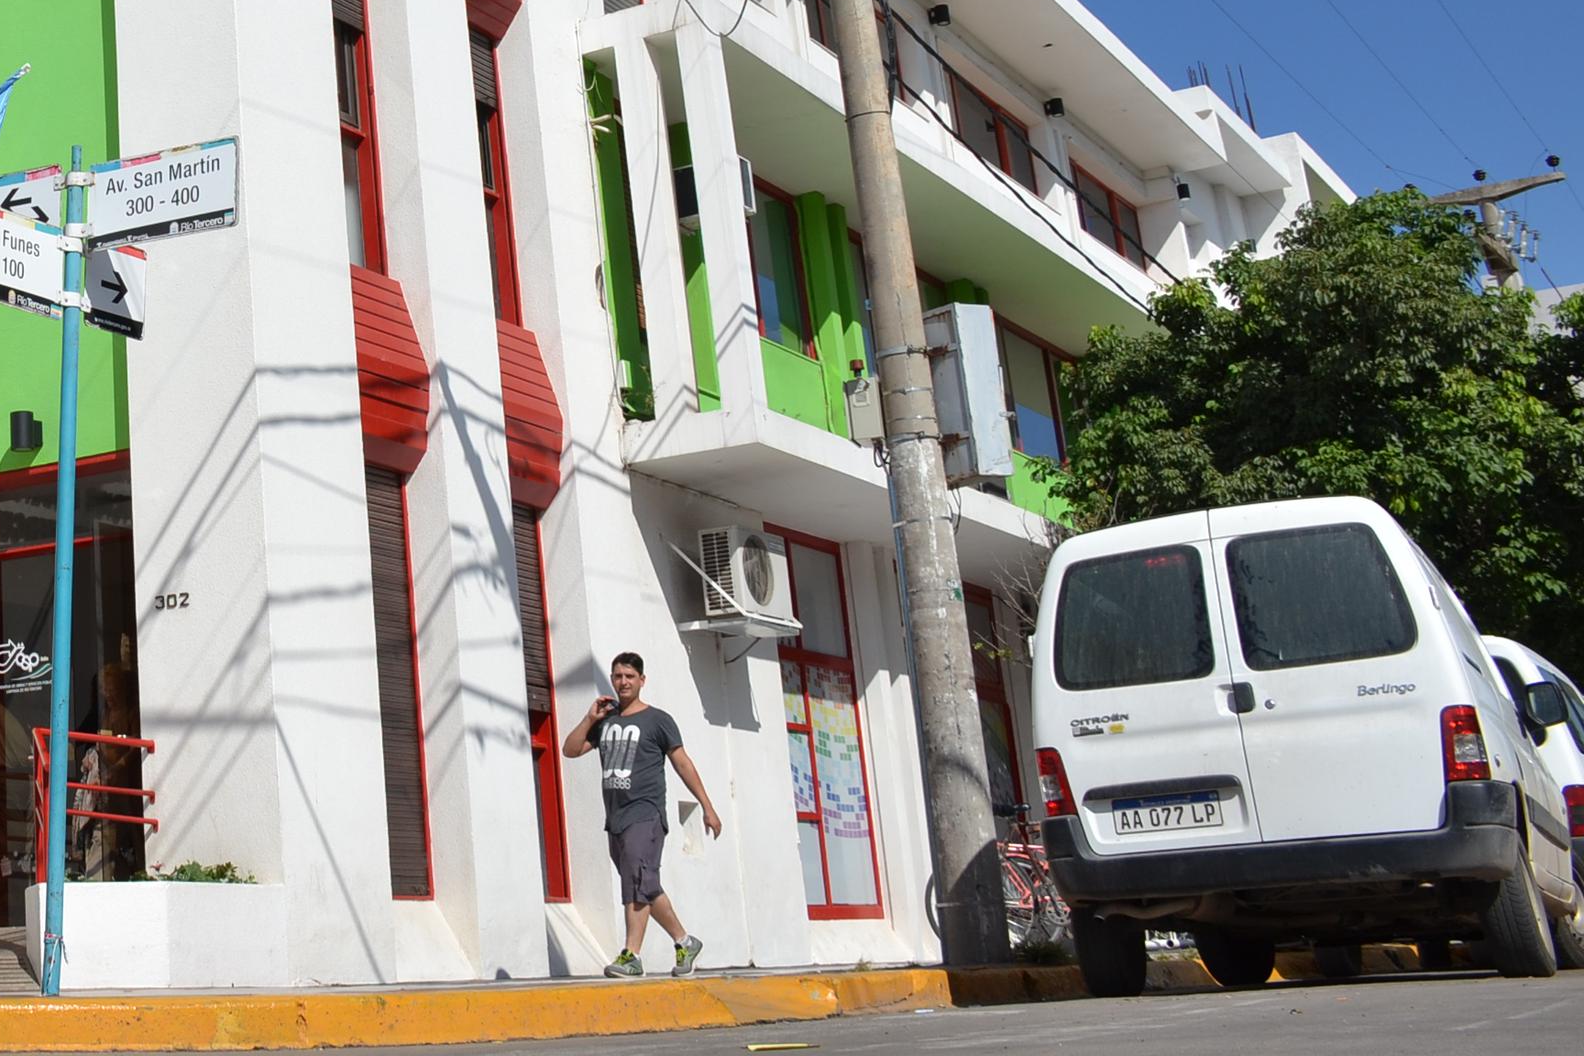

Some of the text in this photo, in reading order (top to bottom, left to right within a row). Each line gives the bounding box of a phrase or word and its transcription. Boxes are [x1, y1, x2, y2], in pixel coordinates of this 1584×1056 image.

[106, 155, 220, 196] Av. San Martín
[126, 194, 154, 217] 300
[171, 185, 200, 207] 400
[194, 217, 224, 230] Tercero
[2, 231, 41, 257] Funes
[2, 258, 25, 279] 100
[27, 298, 51, 314] Tercero
[155, 592, 190, 611] 302
[1357, 683, 1416, 696] Berlingo
[1070, 713, 1130, 727] CITROËN
[1121, 803, 1216, 830] AA 077 LP
